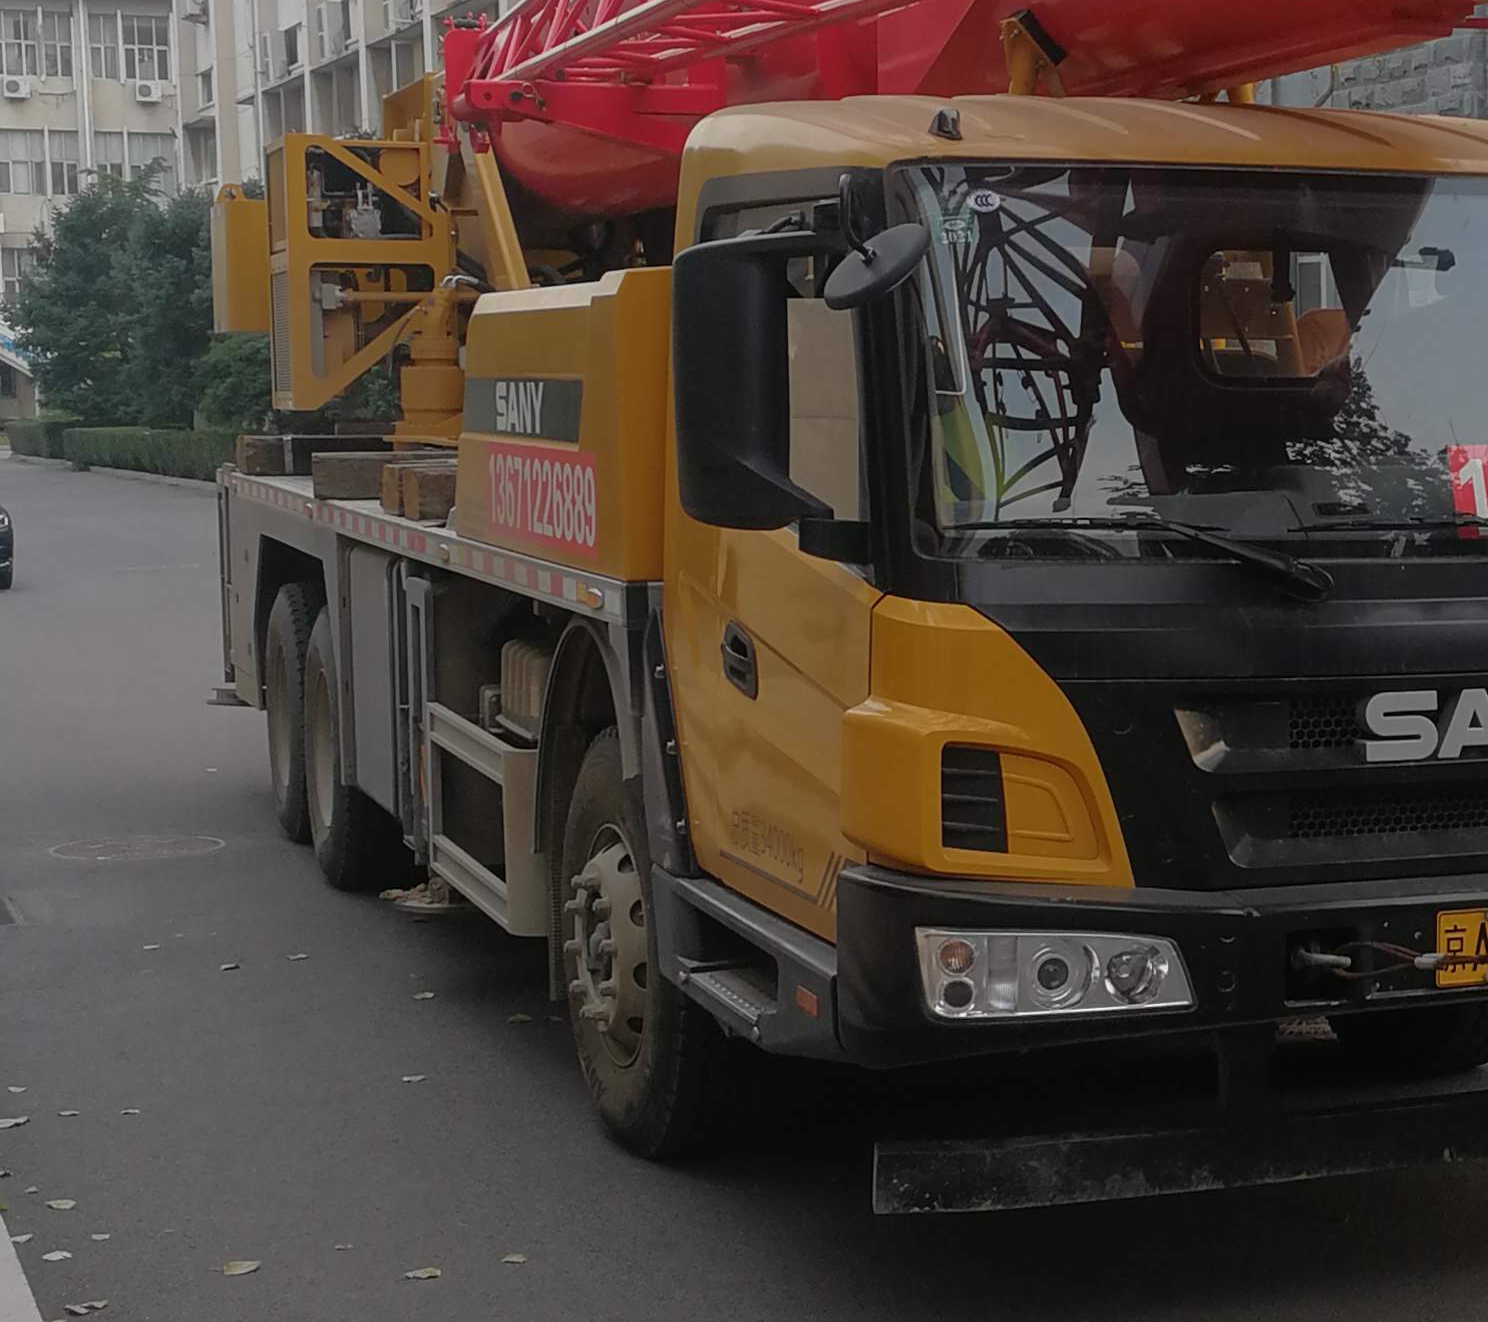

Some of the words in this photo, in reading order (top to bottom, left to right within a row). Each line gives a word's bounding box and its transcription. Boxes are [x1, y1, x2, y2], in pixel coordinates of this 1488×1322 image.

[941, 230, 974, 245] 2021
[495, 381, 545, 435] SANY
[489, 452, 598, 549] 13671226889
